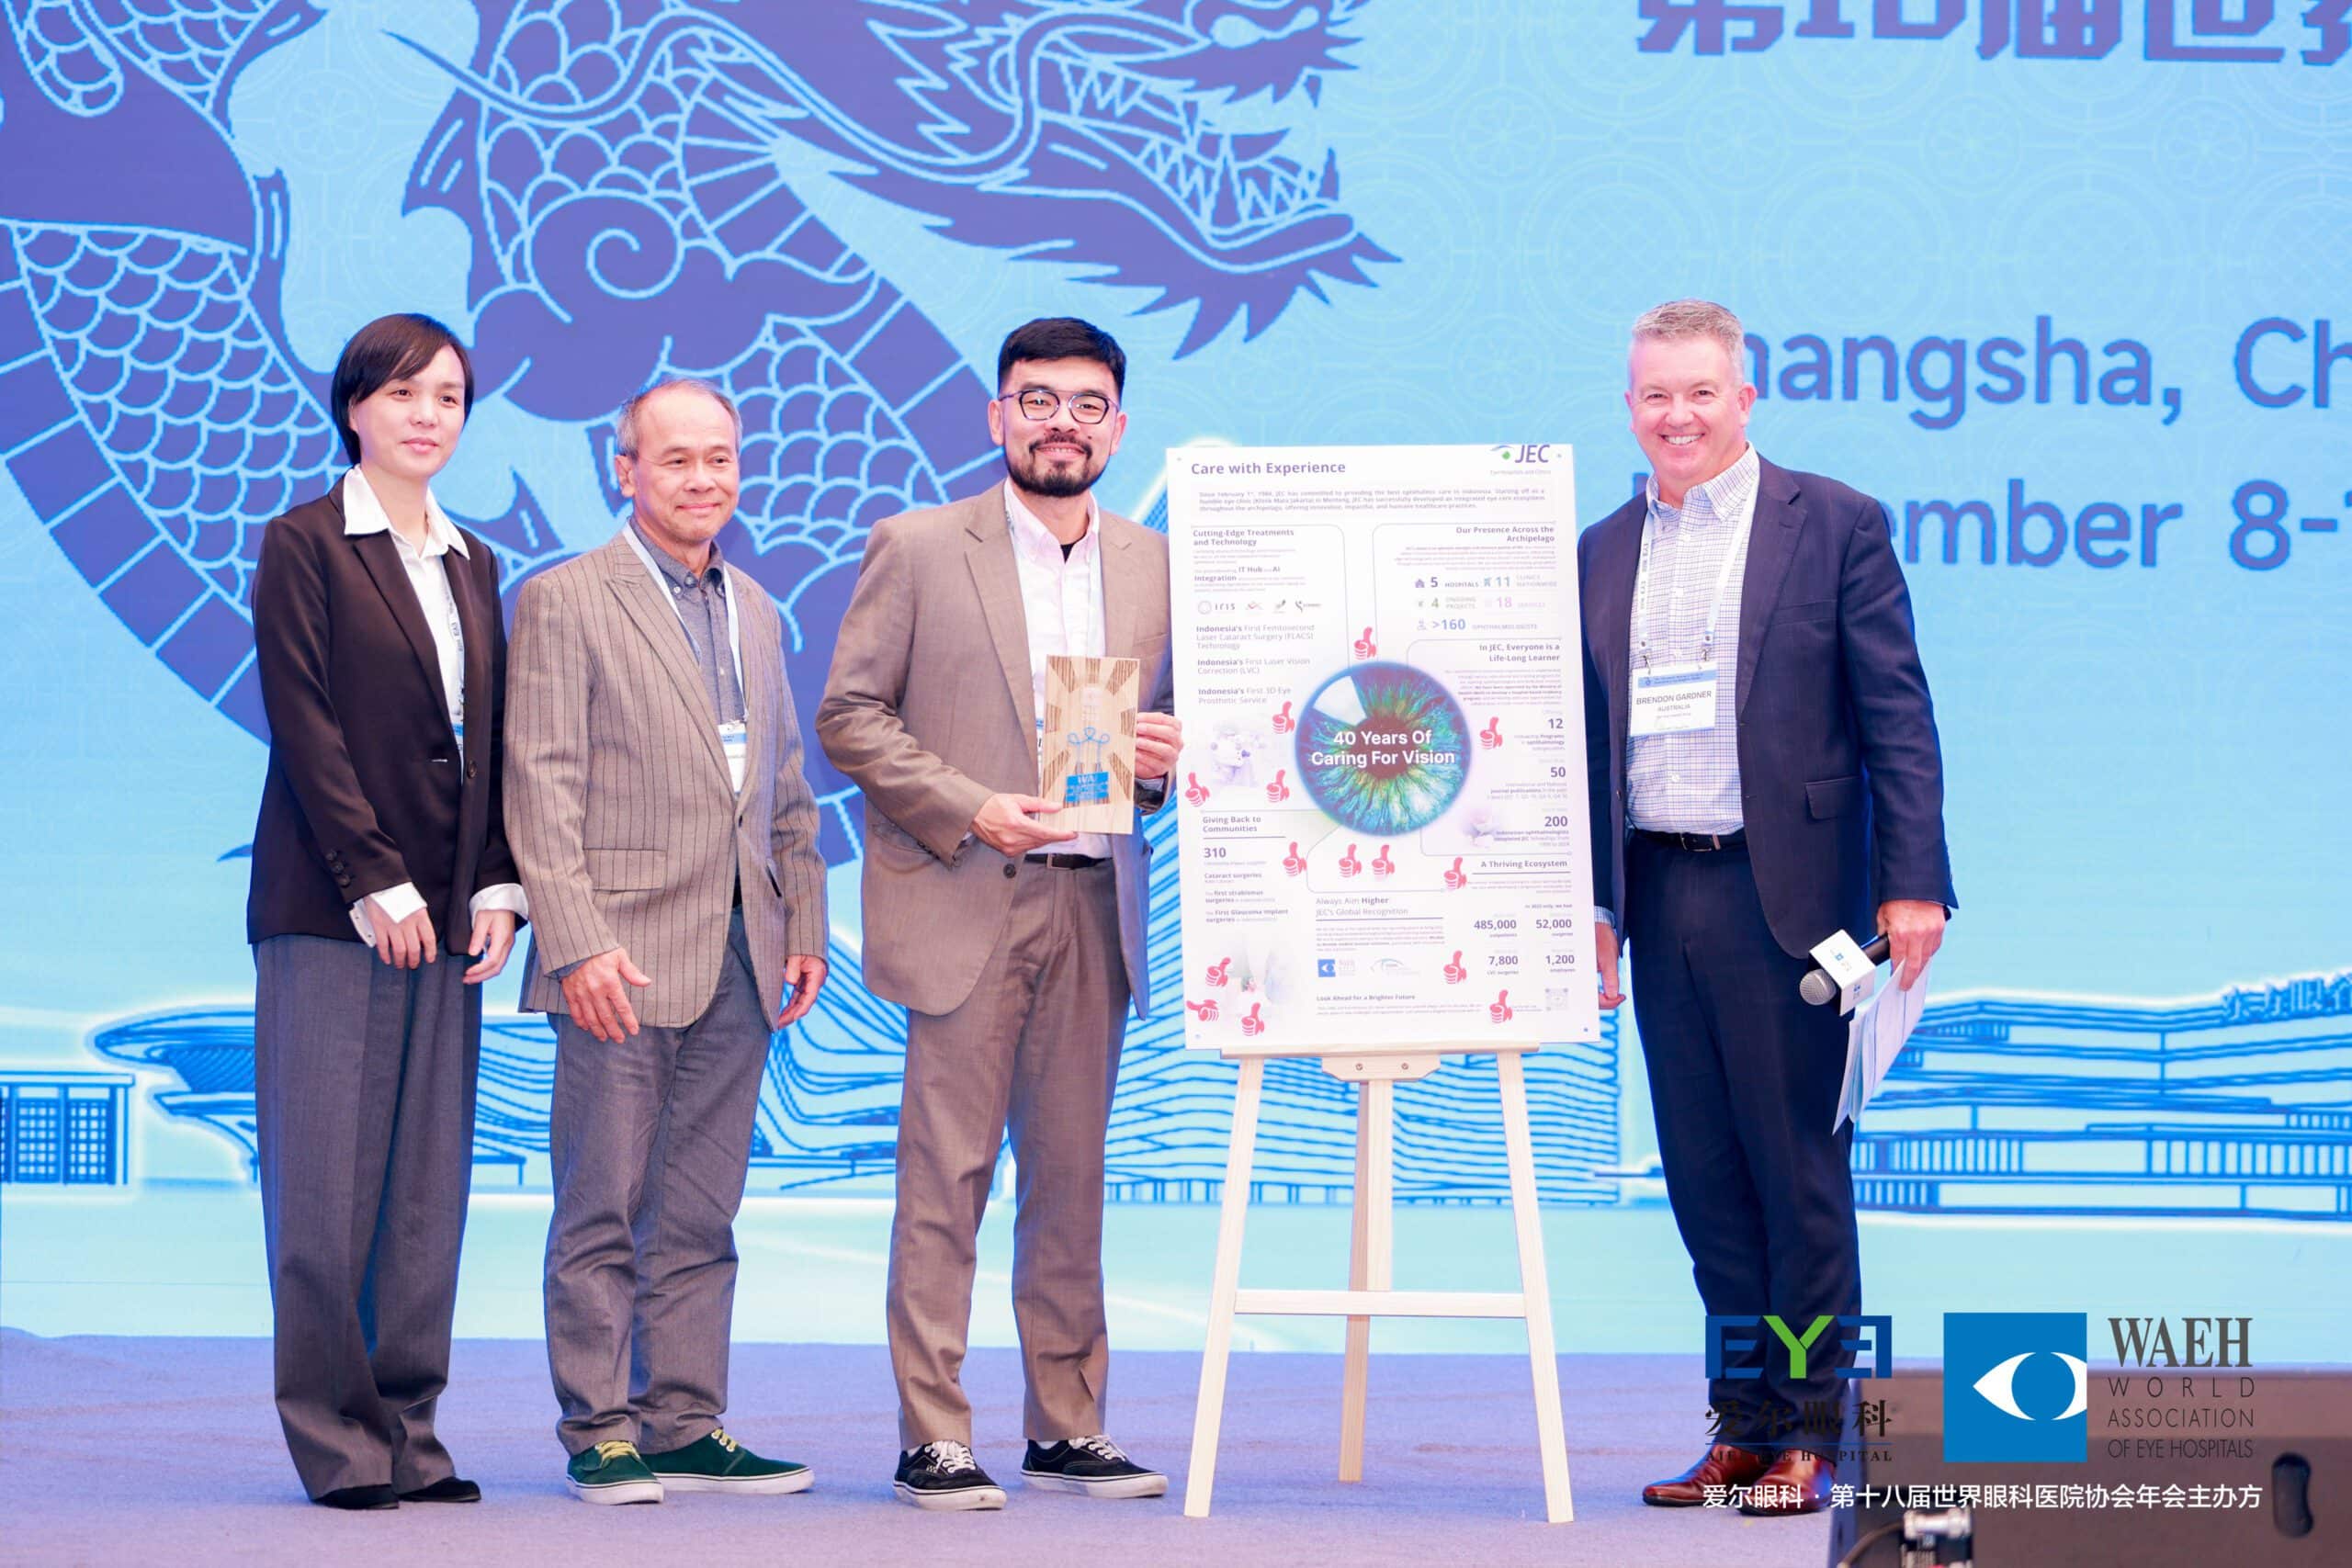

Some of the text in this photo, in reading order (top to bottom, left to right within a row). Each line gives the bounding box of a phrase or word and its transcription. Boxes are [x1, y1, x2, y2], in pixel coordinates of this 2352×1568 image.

[1744, 314, 2182, 430] angsha,
[1514, 445, 1551, 463] JEC
[1191, 461, 1346, 476] Care with Experience
[2228, 479, 2352, 571] 8-
[1193, 528, 1295, 538] Cutting-Edge Treatments
[1193, 538, 1257, 547] and Technology
[1507, 534, 1555, 544] Archipelago
[1194, 574, 1237, 582] Integration
[1430, 577, 1439, 588] 5
[1496, 576, 1511, 588] 11
[1430, 597, 1440, 608] 4
[1497, 596, 1513, 608] 18
[1196, 625, 1243, 633] Indonesia's
[1432, 618, 1467, 631] >160
[1219, 633, 1252, 641] Cataract
[1253, 633, 1283, 642] Surgery
[1489, 644, 1505, 652] JEC,
[1507, 644, 1544, 652] Everyone
[1197, 659, 1244, 667] Indonesia's
[1489, 654, 1560, 663] Life-Long Learner
[1197, 667, 1238, 675] Correction
[1198, 687, 1245, 695] Indonesia's
[1635, 690, 1712, 705] BRENDON GARDNER
[1548, 718, 1564, 729] 12
[1333, 729, 1432, 745] 40 Years Of
[1311, 750, 1455, 769] Caring For Vision
[1550, 766, 1566, 778] 50
[1203, 816, 1228, 825] Giving
[1544, 816, 1568, 828] 200
[1204, 846, 1227, 859] 310
[1489, 860, 1522, 870] Thriving
[1524, 860, 1568, 869] Ecosystem
[1315, 897, 1390, 906] Always Aim Higher
[1315, 908, 1409, 917] JEC's Global Recognition
[1474, 919, 1573, 931] 485,000 52,000
[1487, 954, 1576, 967] 7,800 1,200
